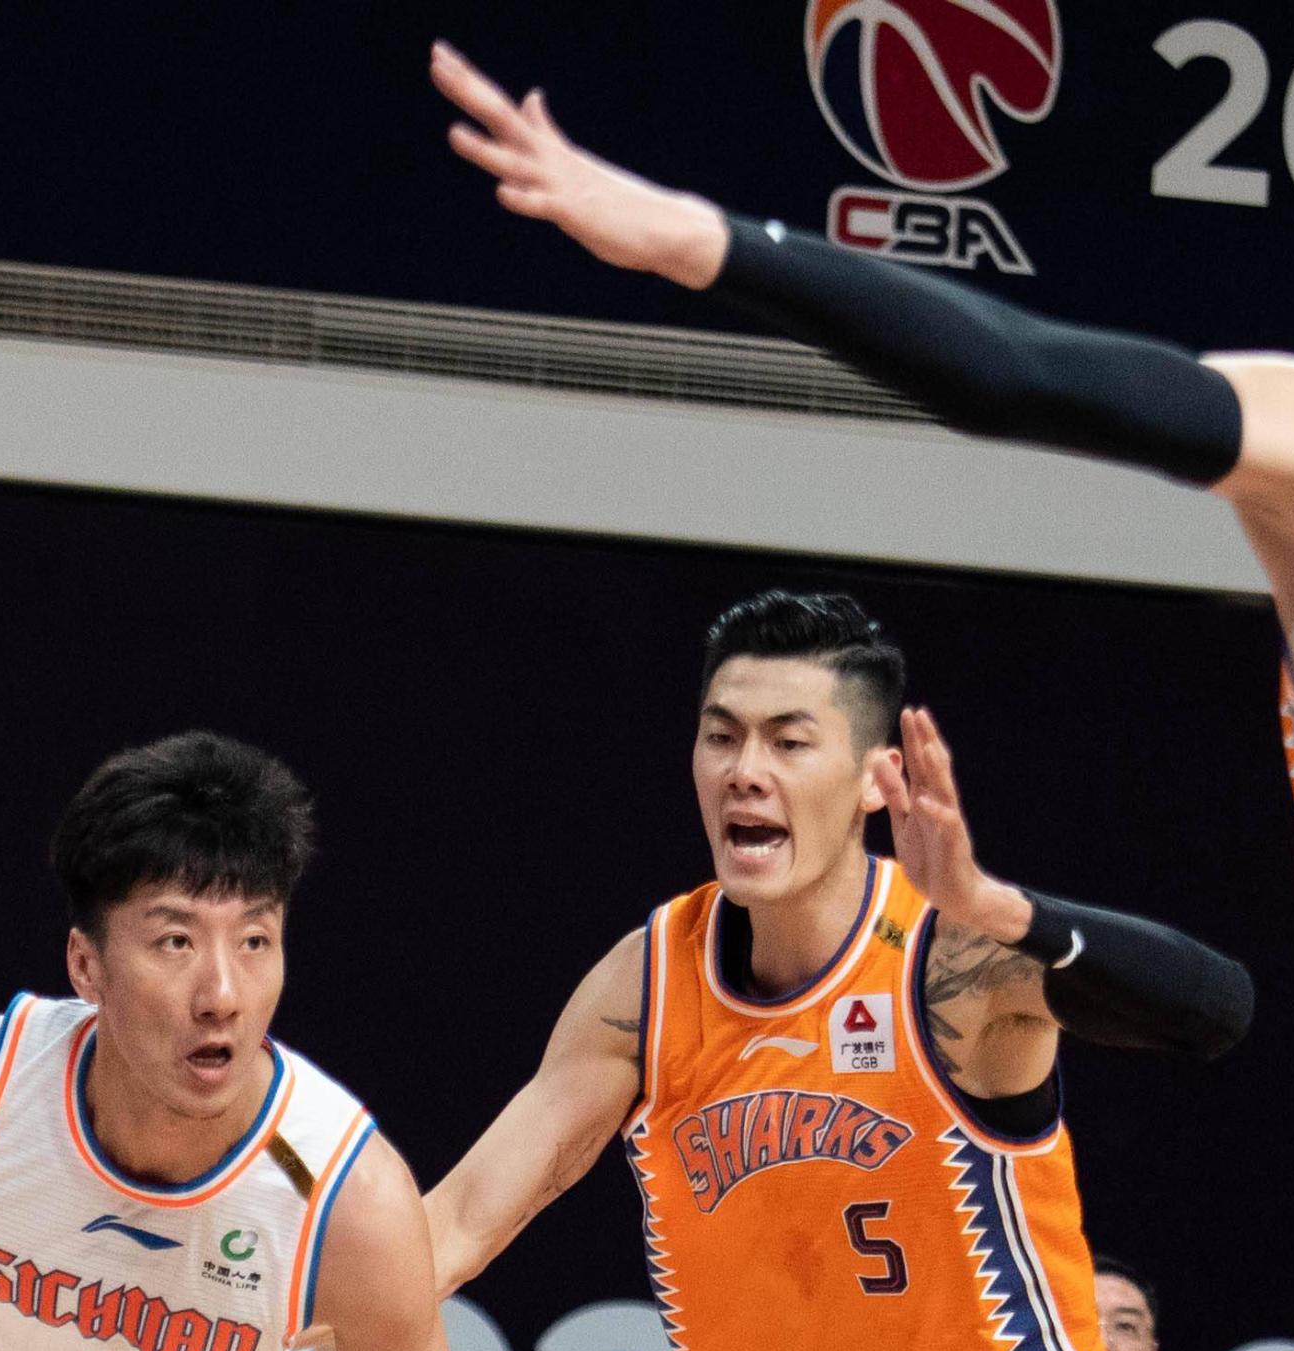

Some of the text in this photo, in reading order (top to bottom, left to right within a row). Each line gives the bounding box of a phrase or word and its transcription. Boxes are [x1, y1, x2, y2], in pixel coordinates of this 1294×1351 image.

[826, 185, 1035, 276] CBA
[851, 1056, 878, 1069] CGB
[673, 1090, 915, 1214] SHARKS
[235, 1282, 258, 1291] LIFE
[843, 1201, 908, 1295] 5
